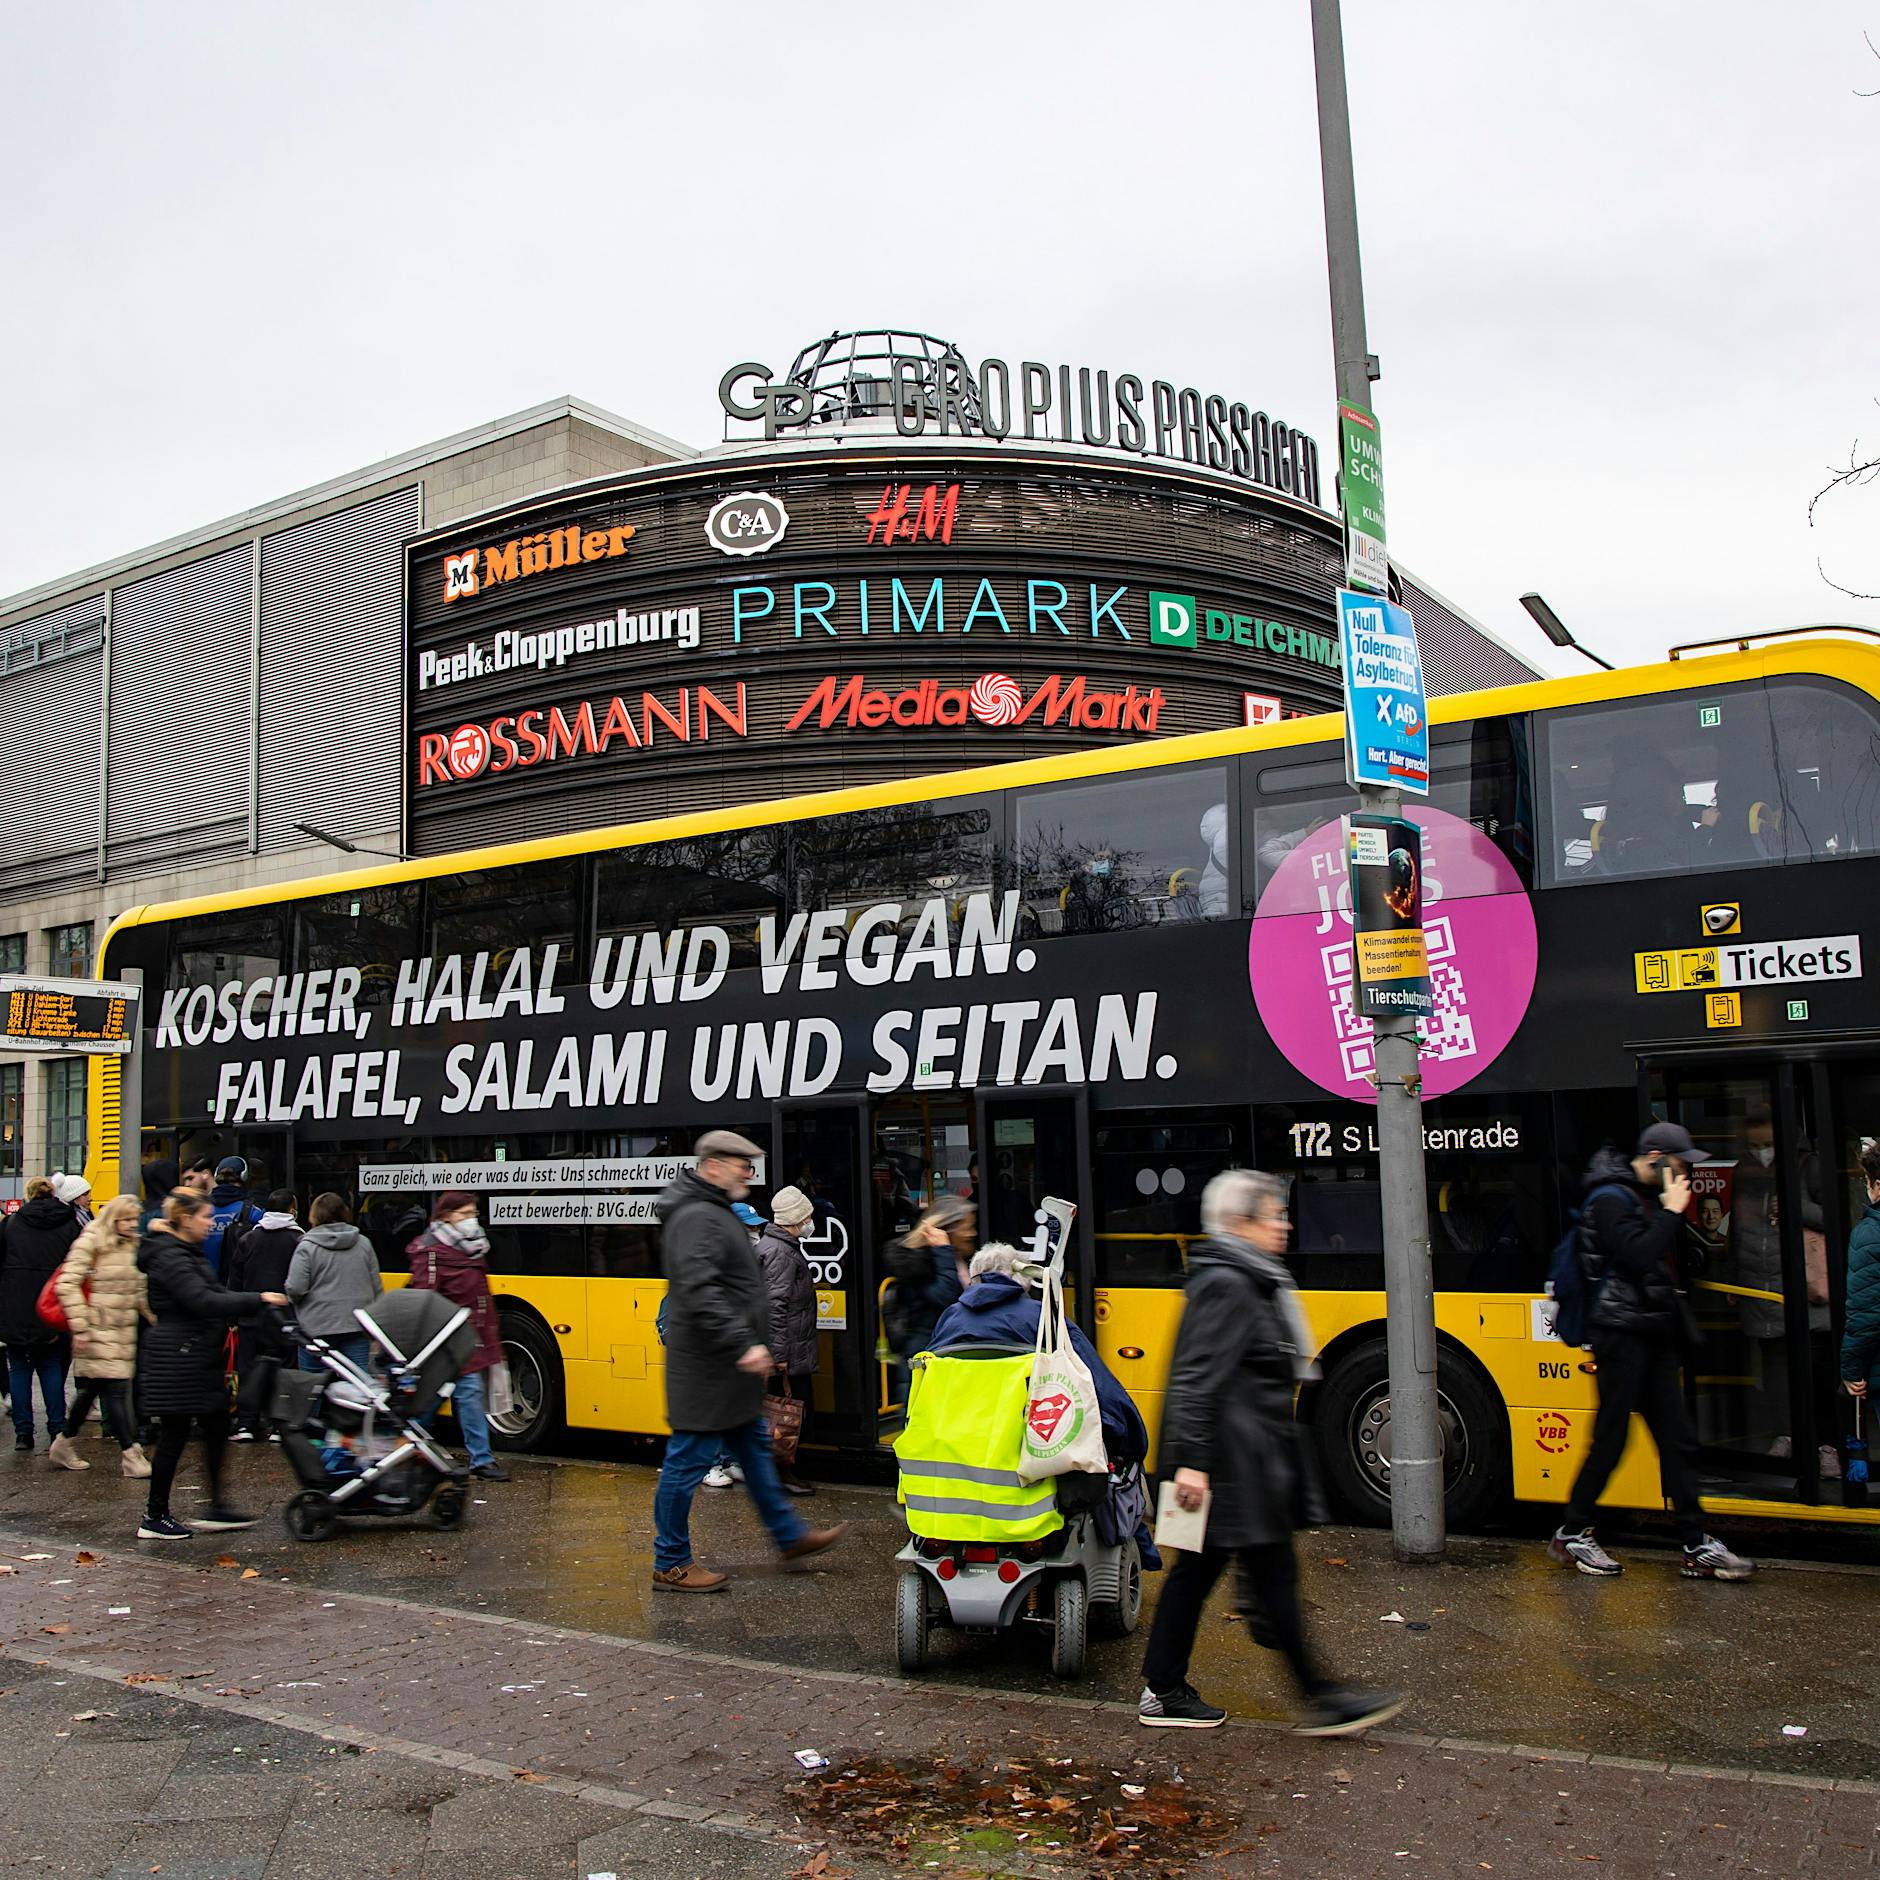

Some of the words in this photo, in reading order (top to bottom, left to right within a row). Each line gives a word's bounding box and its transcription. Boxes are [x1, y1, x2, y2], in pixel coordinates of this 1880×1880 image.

[1350, 434, 1383, 468] UMW
[719, 507, 775, 539] C&A
[865, 484, 960, 546] H&M
[483, 524, 636, 588] Müller
[732, 577, 1133, 643] PRIMARK
[1352, 610, 1377, 633] Null
[1205, 609, 1344, 669] DEICHMA
[1354, 633, 1403, 662] Toleranz
[1395, 702, 1419, 726] AfD
[419, 681, 748, 786] ROSSMANN
[1367, 746, 1388, 764] Hart.
[1388, 750, 1405, 767] Aber
[1363, 935, 1410, 947] Klimawandel
[156, 966, 372, 1049] KOSCHER,
[390, 943, 566, 1027] HALAL
[588, 925, 730, 1010] UND
[757, 889, 1037, 994] VEGAN.
[1366, 963, 1402, 975] beenden!
[1727, 944, 1853, 982] Tickets
[213, 1049, 422, 1125] FALAFEL,
[440, 1029, 668, 1114] SALAMI
[690, 1017, 843, 1102] UND
[866, 991, 1178, 1093] SEITAN.
[1288, 1121, 1333, 1158] 172
[1342, 1126, 1362, 1152] S
[1368, 1120, 1520, 1152] Ltenrade
[363, 1170, 389, 1186] Ganz
[392, 1169, 428, 1189] gleich,
[432, 1168, 452, 1184] wie
[455, 1168, 483, 1184] oder
[486, 1171, 509, 1183] was
[512, 1166, 528, 1183] du
[531, 1167, 557, 1182] isst:
[560, 1166, 584, 1182] Uns
[587, 1165, 650, 1182] schmeckt
[1691, 1178, 1727, 1194] OPP
[493, 1203, 524, 1219] Jetzt
[526, 1201, 593, 1218] bewerben:
[597, 1201, 660, 1219] BVG.de/K
[1538, 1362, 1570, 1380] BVG
[1538, 1426, 1568, 1439] VBB
